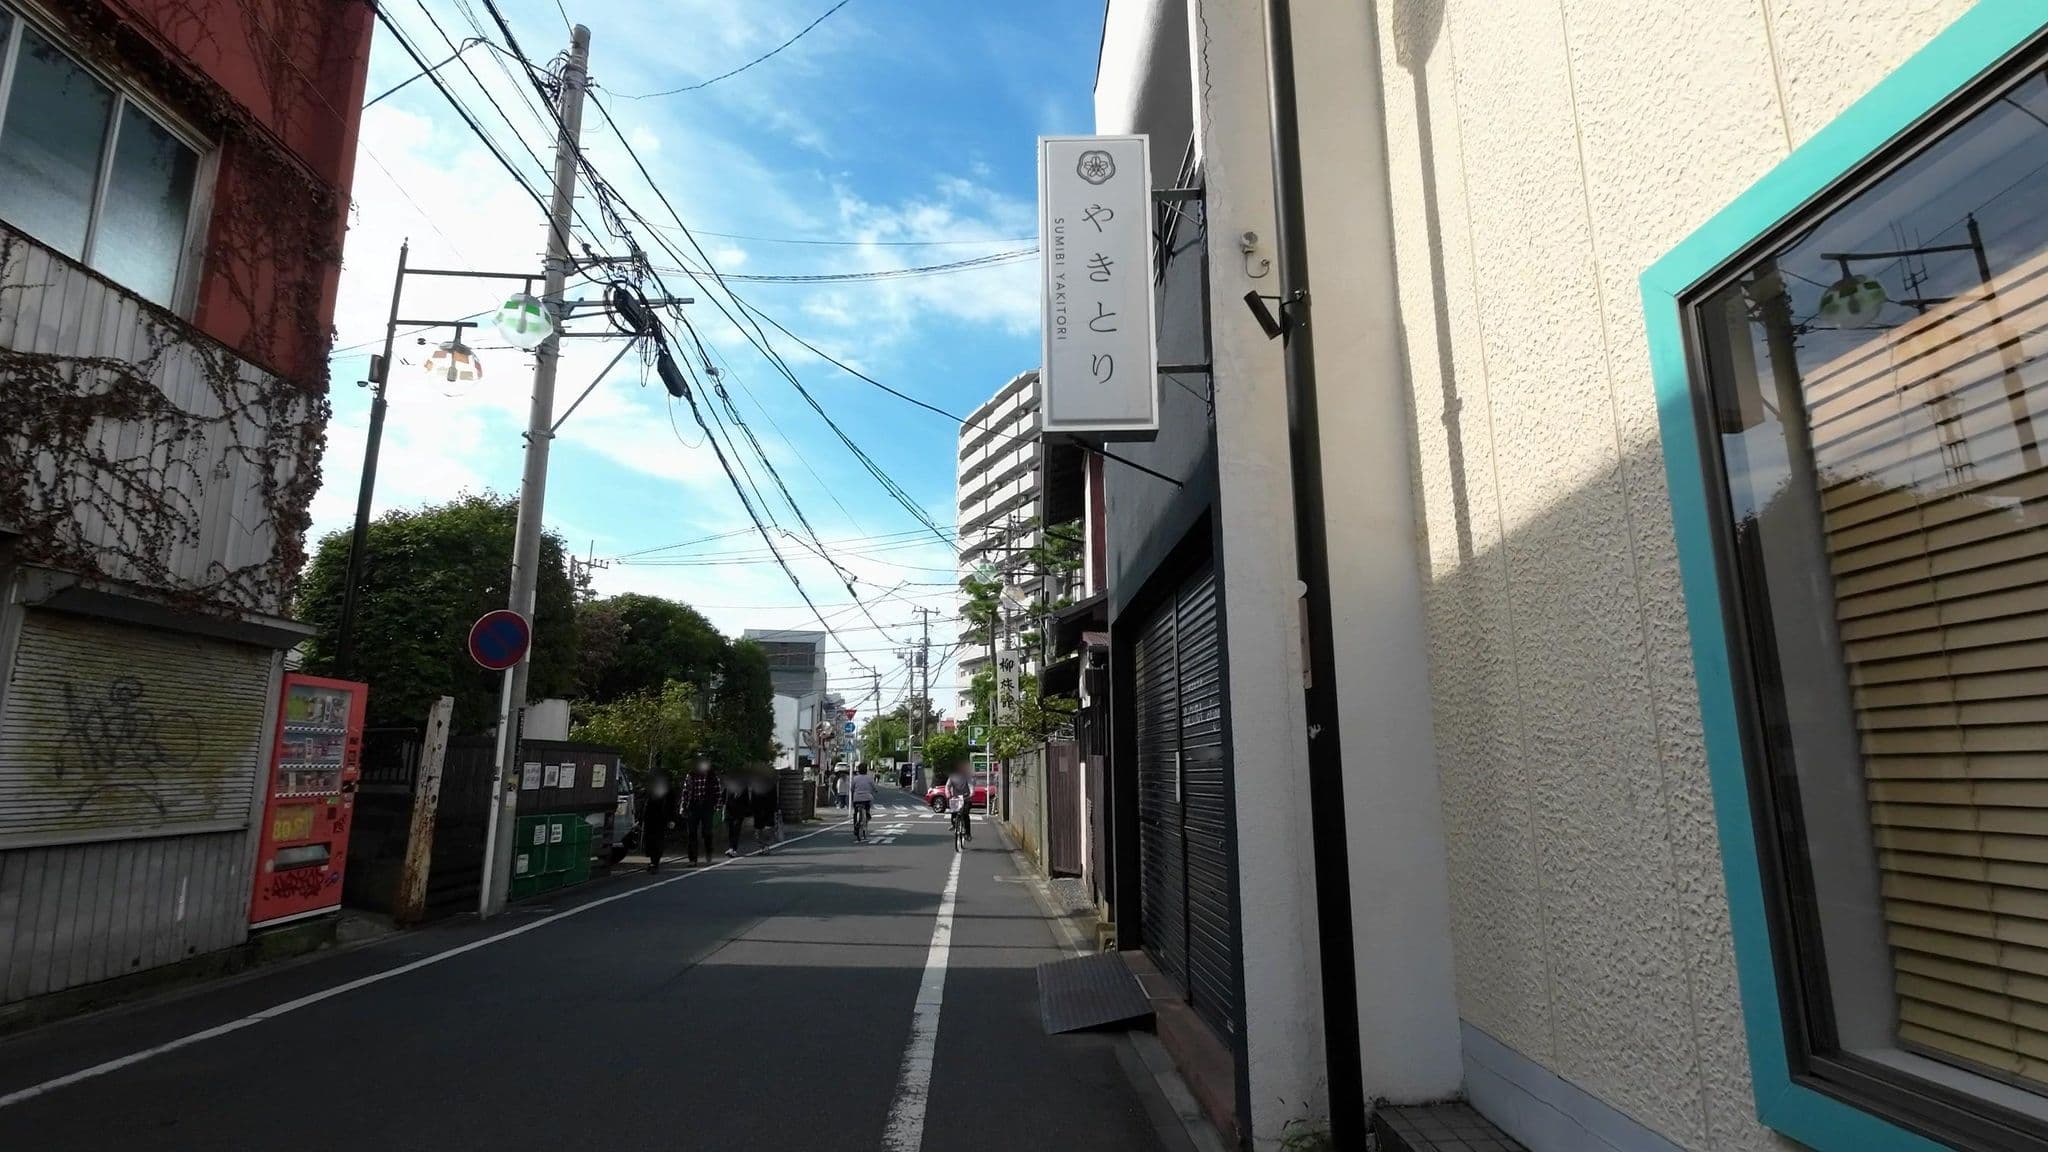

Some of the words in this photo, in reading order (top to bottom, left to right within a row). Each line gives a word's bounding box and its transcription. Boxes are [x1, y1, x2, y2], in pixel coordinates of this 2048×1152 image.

[1054, 218, 1065, 265] SUMIBI
[1055, 272, 1067, 340] YAKITORI
[1082, 204, 1117, 384] やきとり
[974, 727, 984, 739] P
